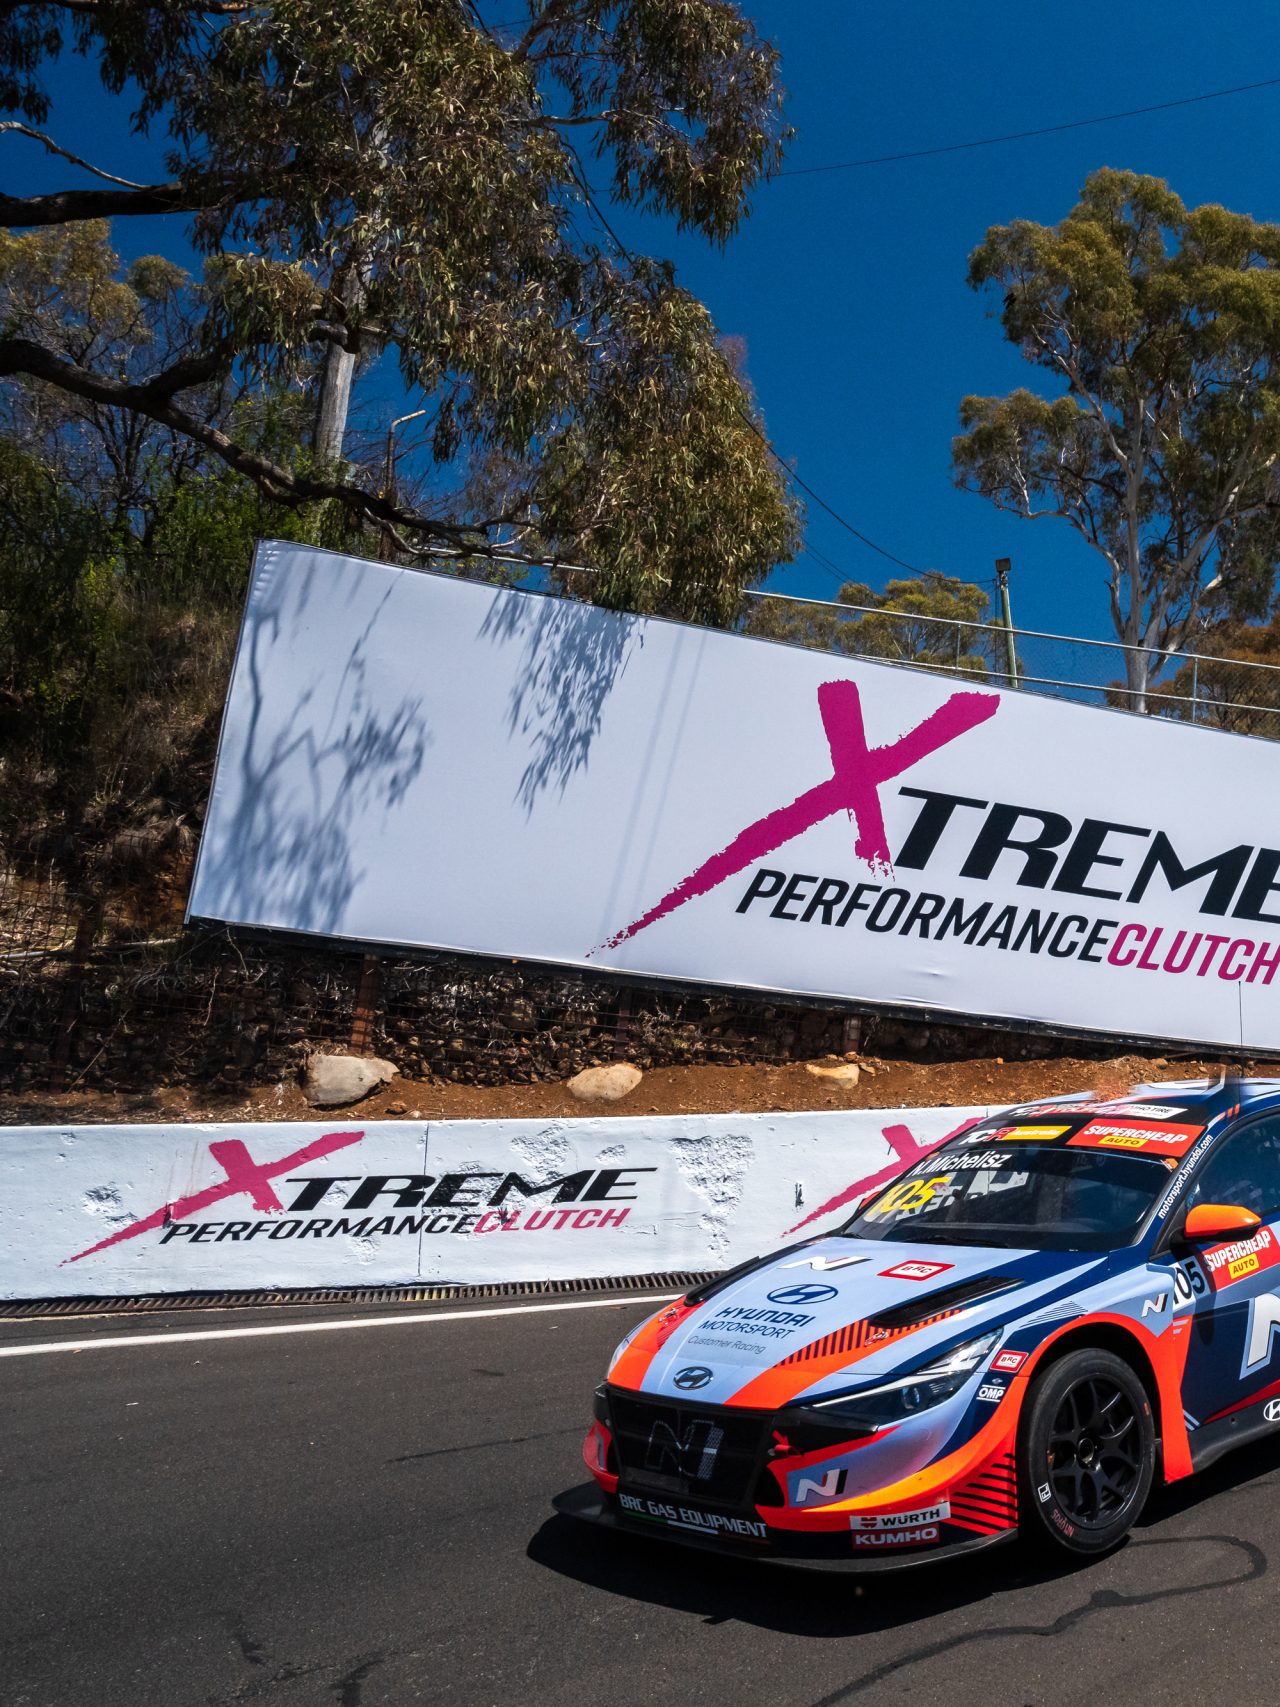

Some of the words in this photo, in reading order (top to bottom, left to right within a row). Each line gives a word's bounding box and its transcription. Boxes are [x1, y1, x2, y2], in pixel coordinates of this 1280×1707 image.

[1083, 1125, 1188, 1144] SUPERCHEAP
[1105, 1136, 1140, 1146] AUTO
[906, 1151, 1013, 1178] N.Michelisz
[1158, 1134, 1213, 1219] motorsport.hyundai.com
[866, 1176, 953, 1216] 105
[1204, 1230, 1271, 1272] SUPERCHEAP
[901, 1265, 933, 1274] BRC
[1233, 1258, 1255, 1274] AUTO
[714, 1307, 816, 1327] HYUNDAI
[698, 1320, 796, 1339] MOTORSPORT
[687, 1335, 732, 1348] Customer
[732, 1340, 767, 1354] Racing
[1001, 1356, 1018, 1364] BRC
[978, 1386, 1004, 1400] OMP
[619, 1493, 645, 1512] BRC
[647, 1501, 677, 1519] GAS
[680, 1509, 767, 1538] EQUIPMENT
[881, 1509, 940, 1527] WÜRTH
[855, 1528, 938, 1544] KUMHO
